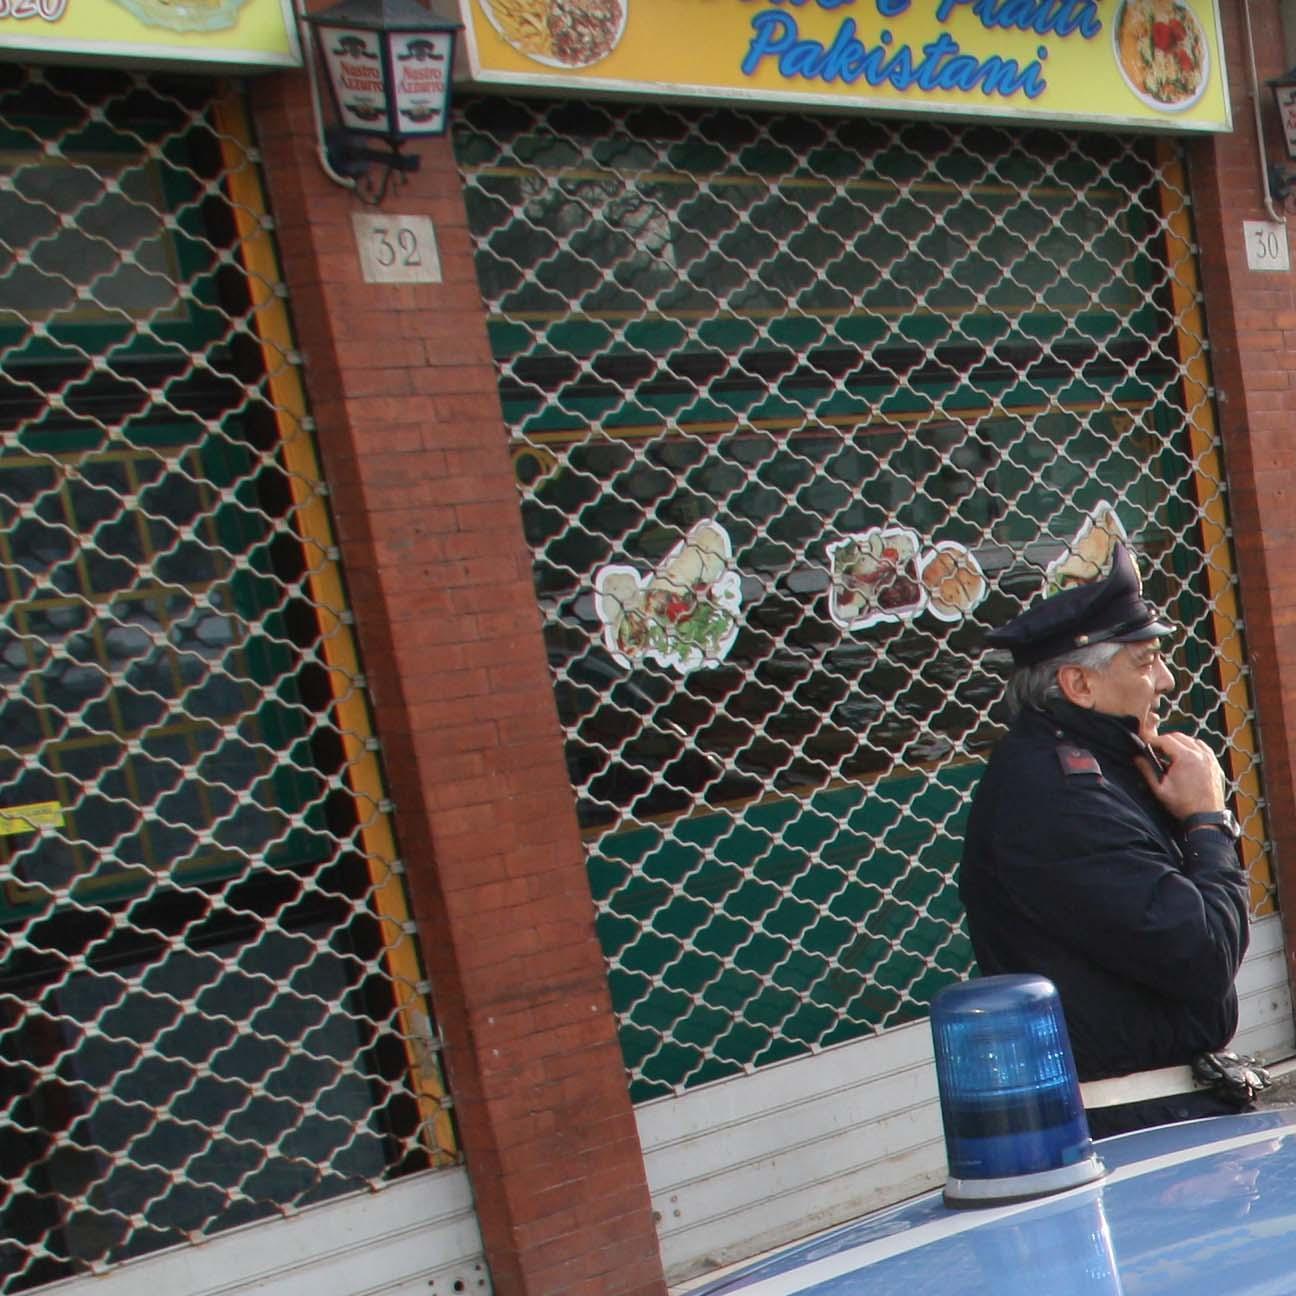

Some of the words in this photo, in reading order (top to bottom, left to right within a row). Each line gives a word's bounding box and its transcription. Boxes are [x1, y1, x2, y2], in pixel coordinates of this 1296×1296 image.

[741, 9, 1048, 99] Pakistani
[373, 228, 422, 266] 32
[1255, 230, 1279, 259] 30
